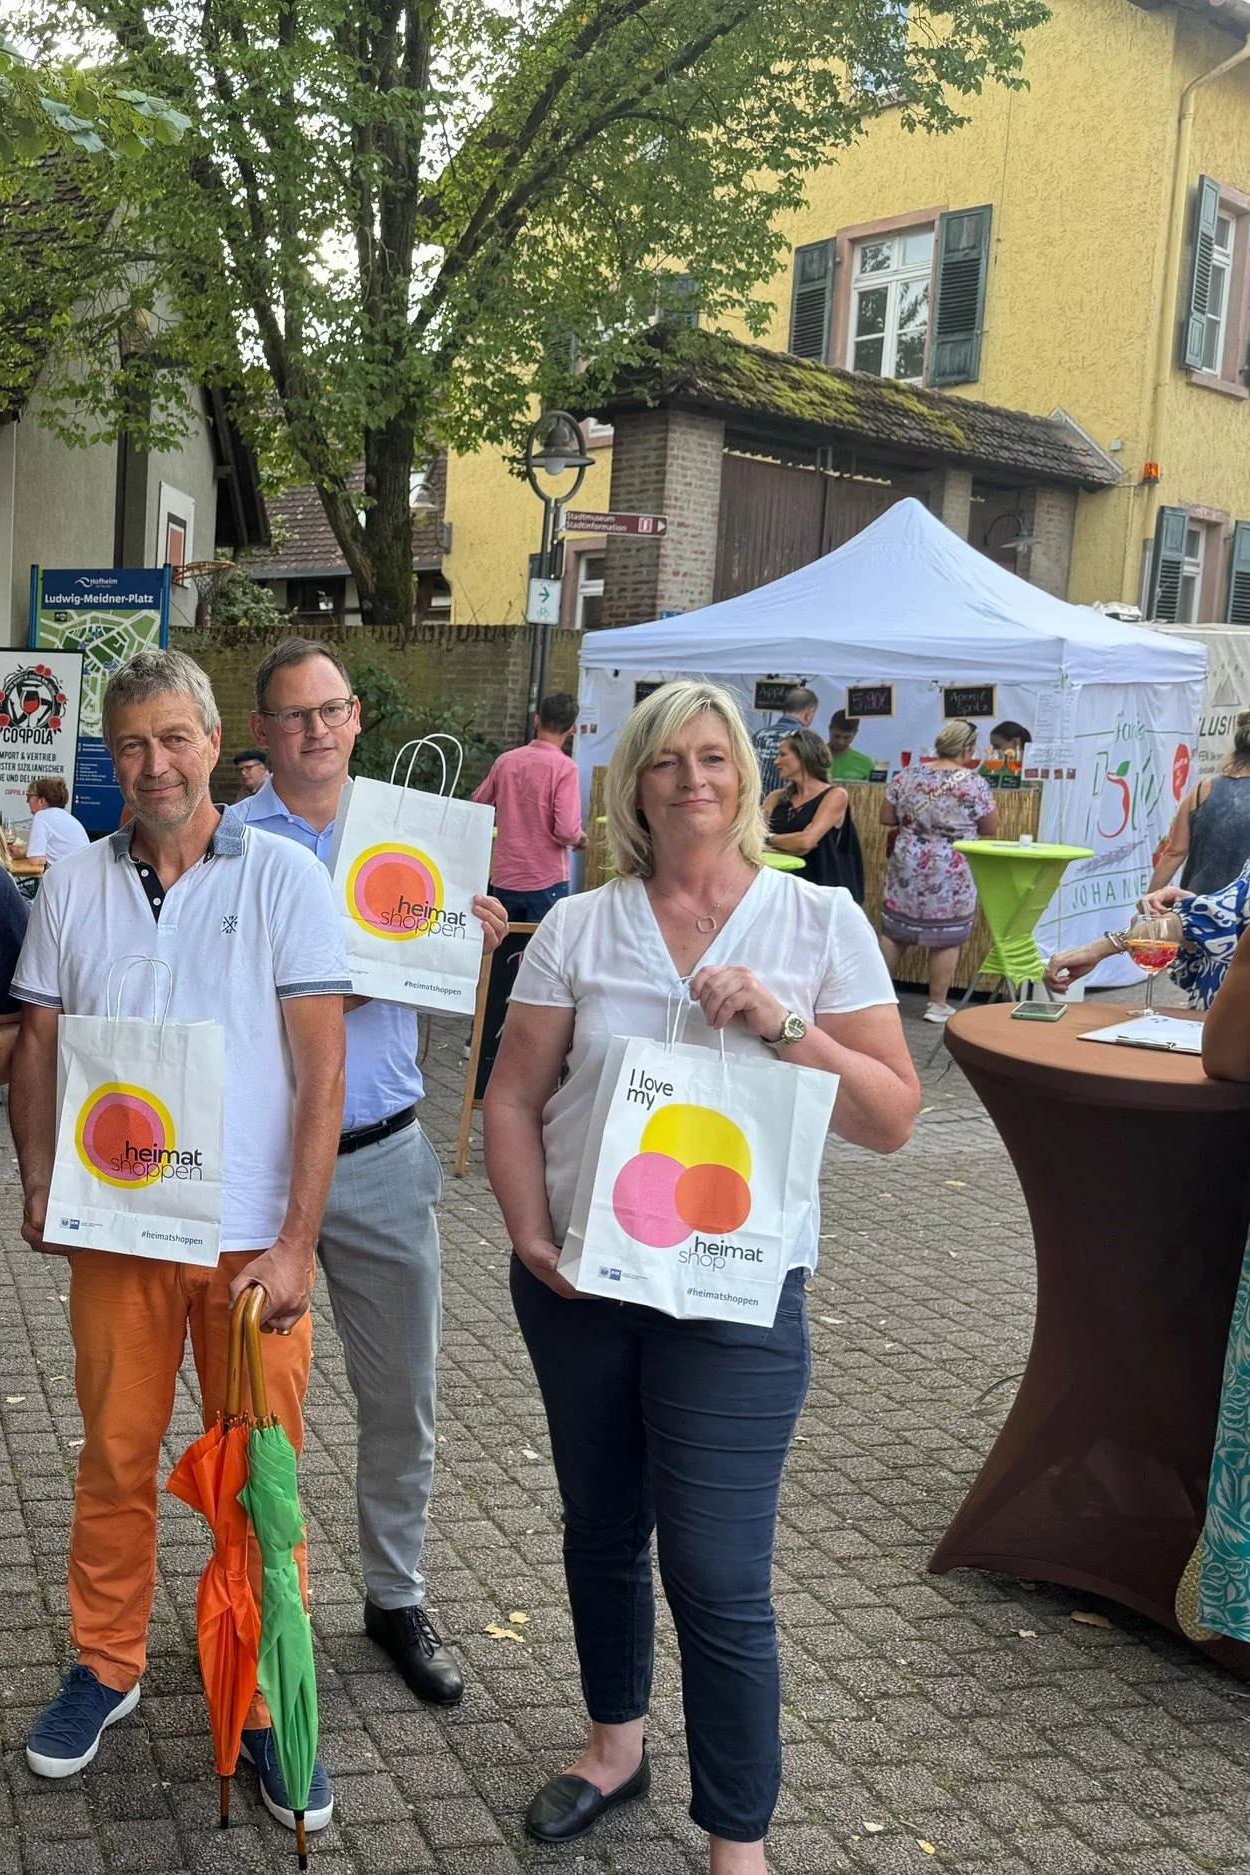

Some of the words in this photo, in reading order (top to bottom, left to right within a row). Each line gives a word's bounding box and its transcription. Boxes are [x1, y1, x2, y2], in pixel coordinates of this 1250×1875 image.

[566, 512, 615, 523] Stadtmuseum
[566, 521, 627, 532] Stadtinformation
[90, 577, 118, 585] Hofheim
[44, 593, 154, 605] Ludwig-Meidner-Platz
[1198, 715, 1236, 736] LUSI
[3, 727, 53, 745] COPPOLA
[21, 752, 25, 760] &
[27, 752, 57, 762] VERTRIEB
[6, 773, 18, 782] UND
[17, 763, 64, 773] SIZILIANISCHER
[398, 896, 467, 927] heimat
[379, 907, 466, 940] shoppen
[403, 981, 462, 996] #heimatshoppen
[629, 1068, 636, 1086] I
[640, 1070, 674, 1097] love
[626, 1088, 656, 1110] my
[125, 1141, 203, 1167] heimat
[110, 1154, 203, 1183] shoppen
[141, 1231, 203, 1246] #heimatshoppen
[694, 1236, 764, 1263] heimat
[678, 1247, 726, 1273] shop
[686, 1287, 759, 1307] #heimatshoppen
